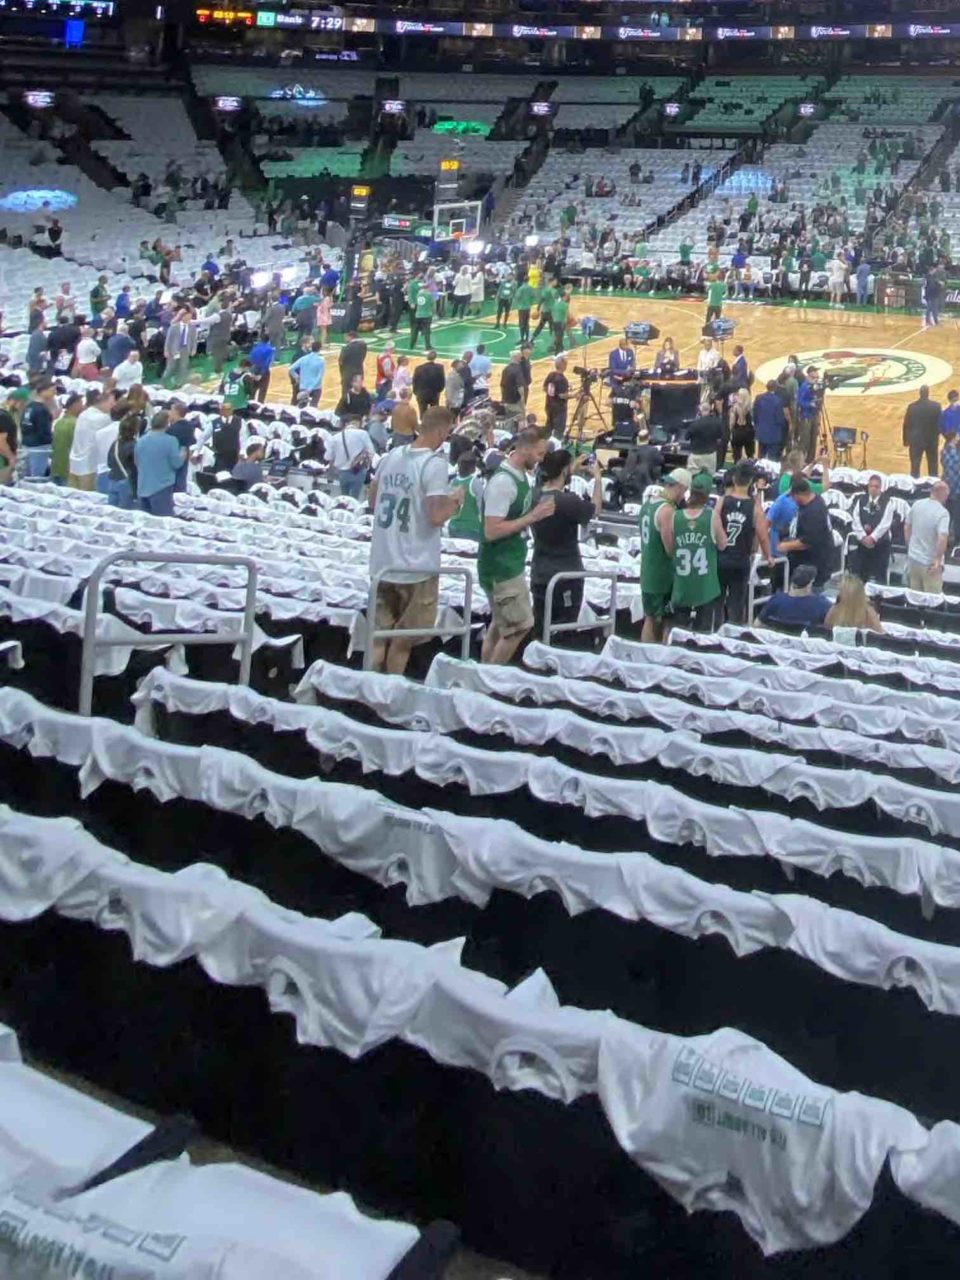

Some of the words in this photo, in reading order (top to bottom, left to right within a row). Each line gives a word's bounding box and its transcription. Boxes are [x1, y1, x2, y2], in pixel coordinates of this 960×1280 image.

[276, 14, 302, 24] Bank
[311, 17, 342, 29] 7:29
[377, 493, 411, 533] 34
[676, 532, 708, 547] PIERCE
[726, 522, 742, 546] 7
[675, 547, 708, 576] 34
[752, 1123, 768, 1142] ALL
